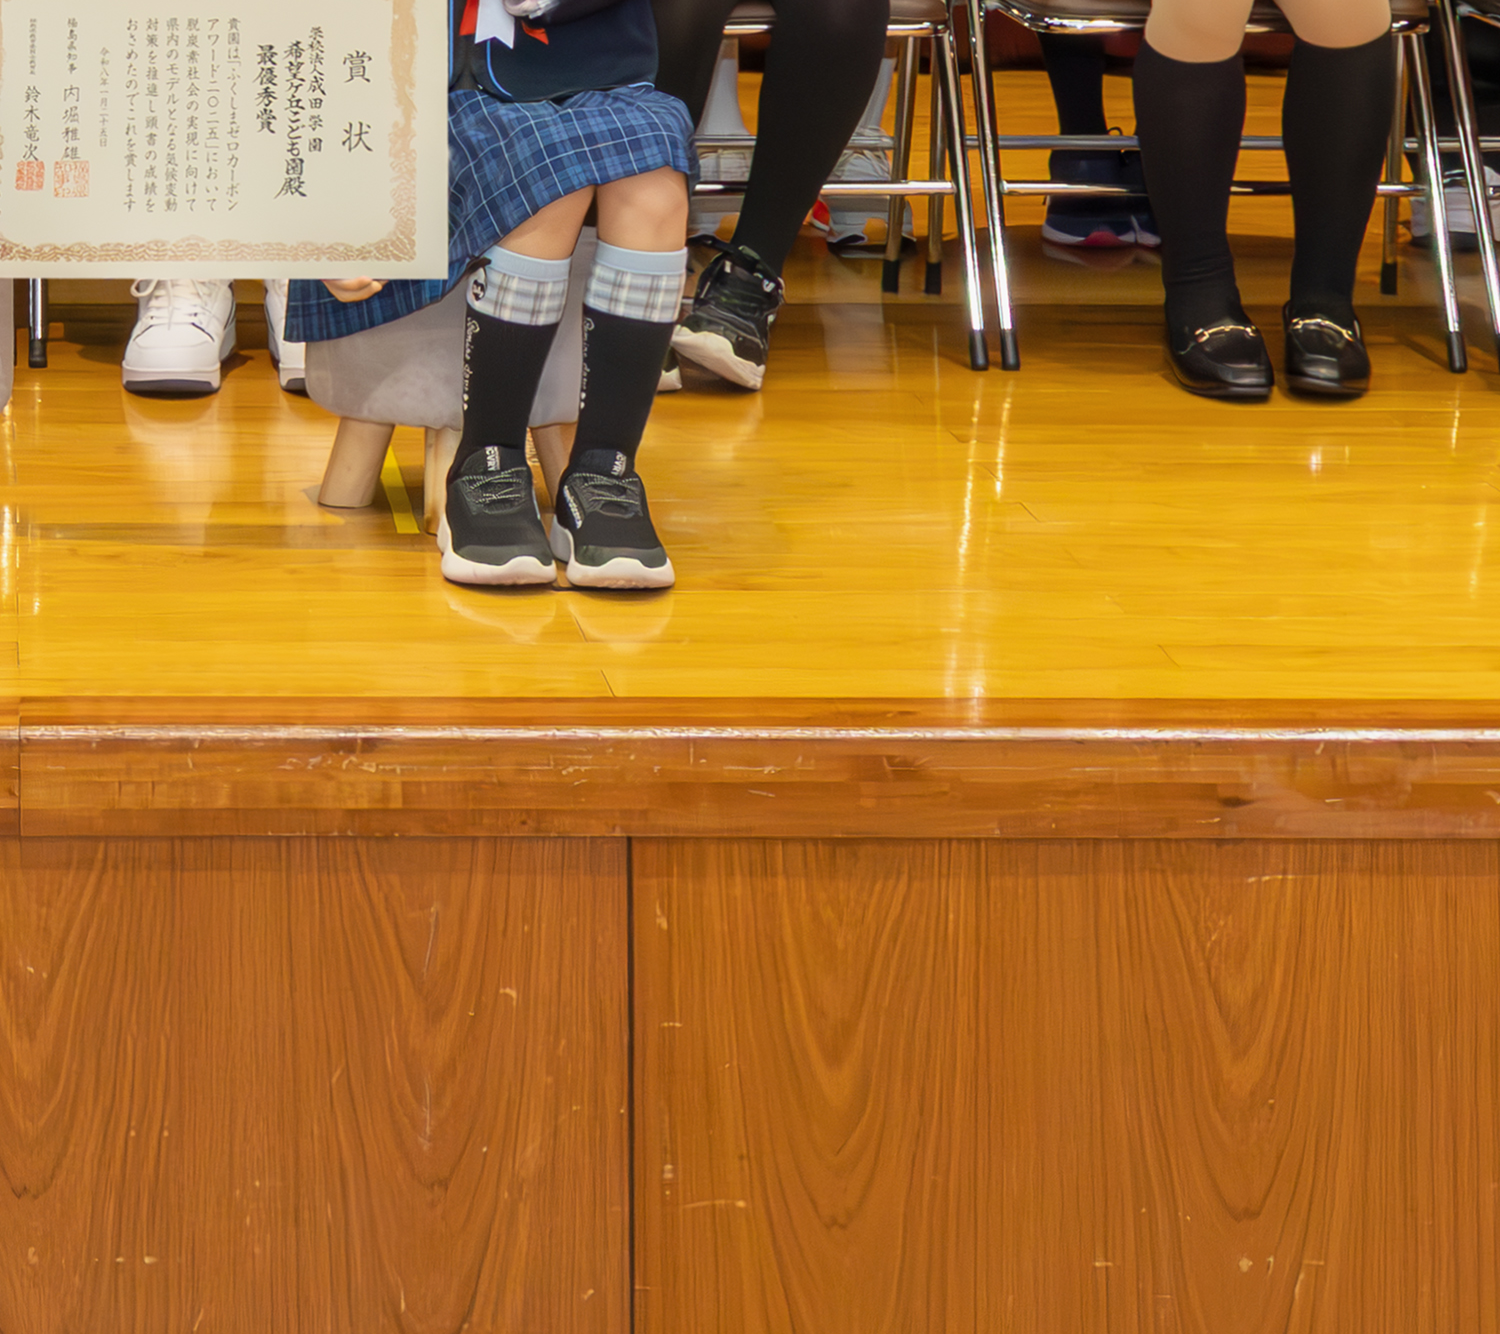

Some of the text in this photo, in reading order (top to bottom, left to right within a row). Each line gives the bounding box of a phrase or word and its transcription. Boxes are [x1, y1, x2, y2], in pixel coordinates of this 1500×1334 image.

[22, 85, 41, 161] 鈴木竜次
[61, 84, 81, 160] 内堀雅雄
[252, 44, 278, 135] 最優秀賞
[341, 49, 374, 153] 賞状
